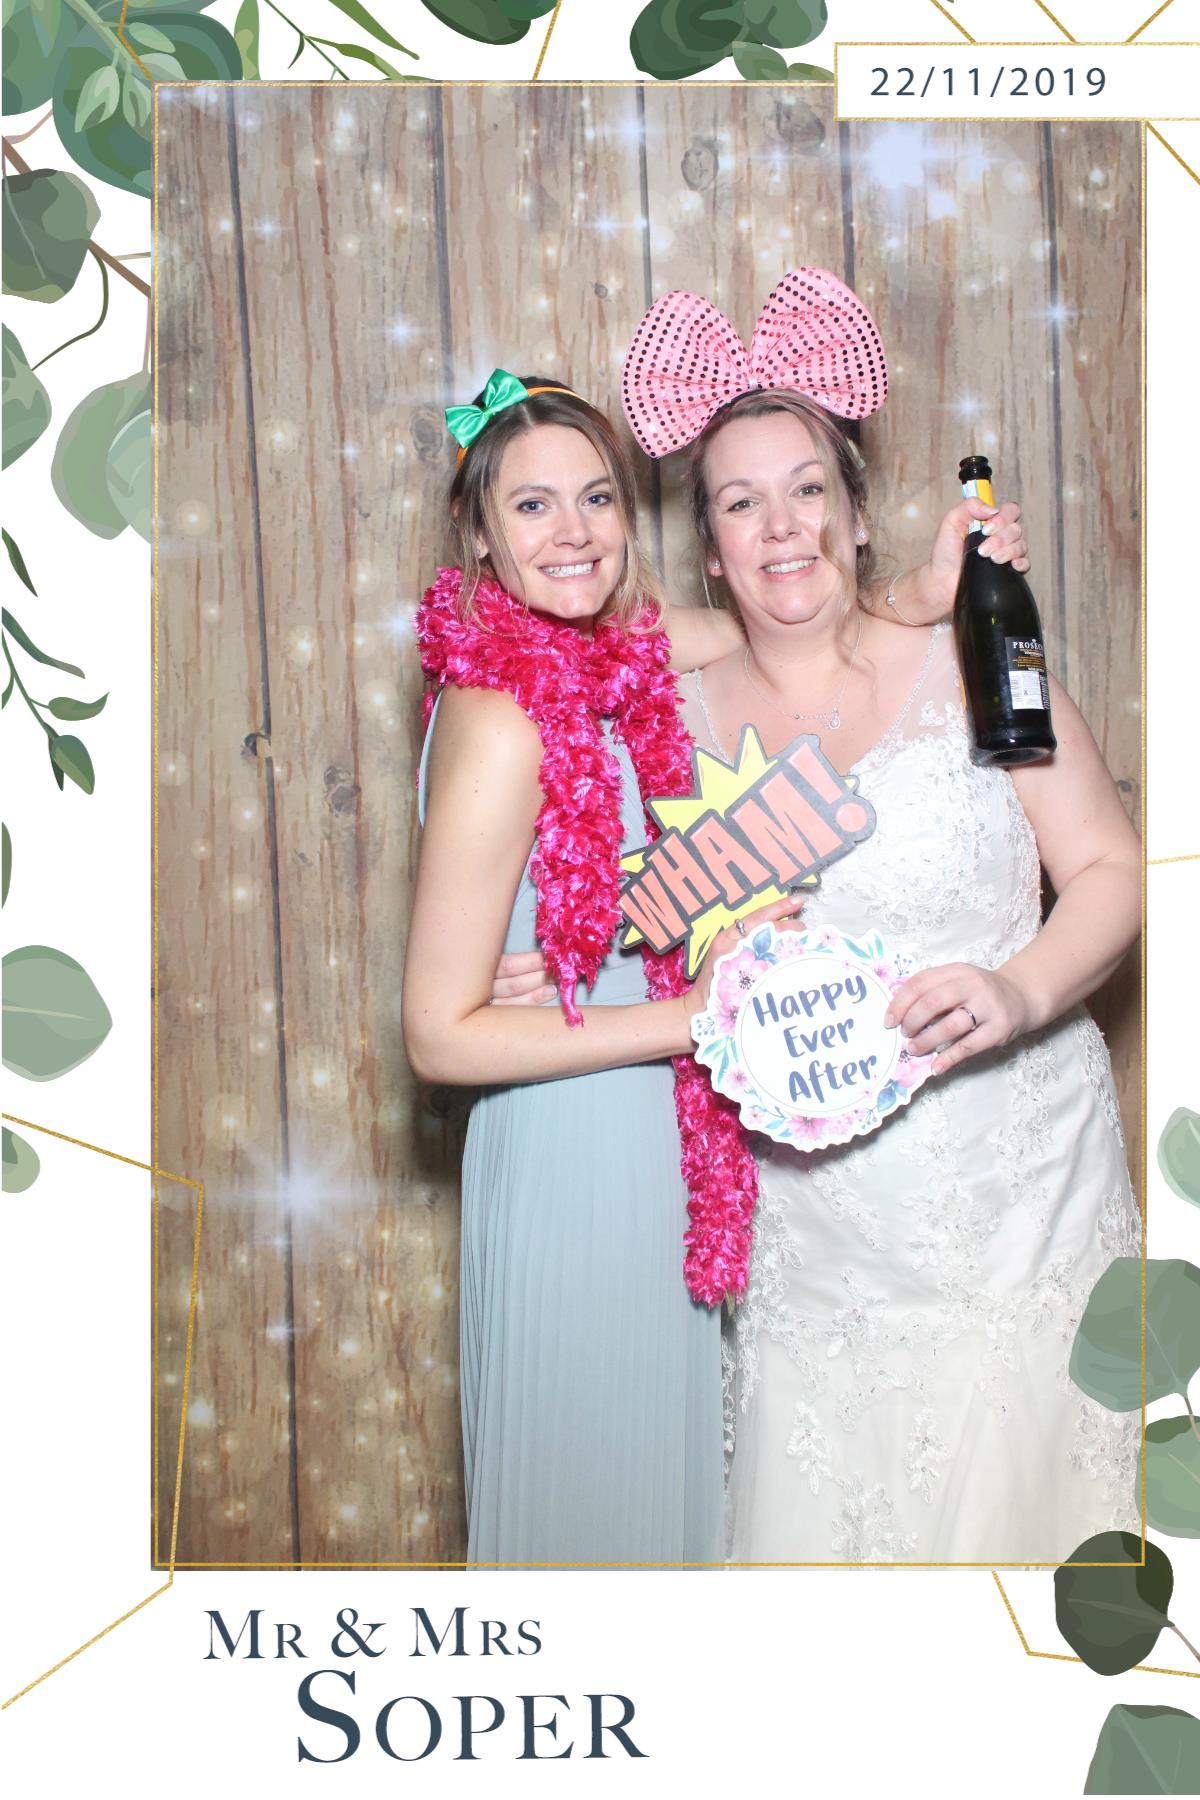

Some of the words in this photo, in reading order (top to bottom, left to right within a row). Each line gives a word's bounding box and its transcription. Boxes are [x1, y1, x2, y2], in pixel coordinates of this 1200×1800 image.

[618, 742, 868, 951] WHAM!
[752, 975, 867, 1027] Happy
[782, 1017, 855, 1058] Ever
[788, 1054, 877, 1104] After
